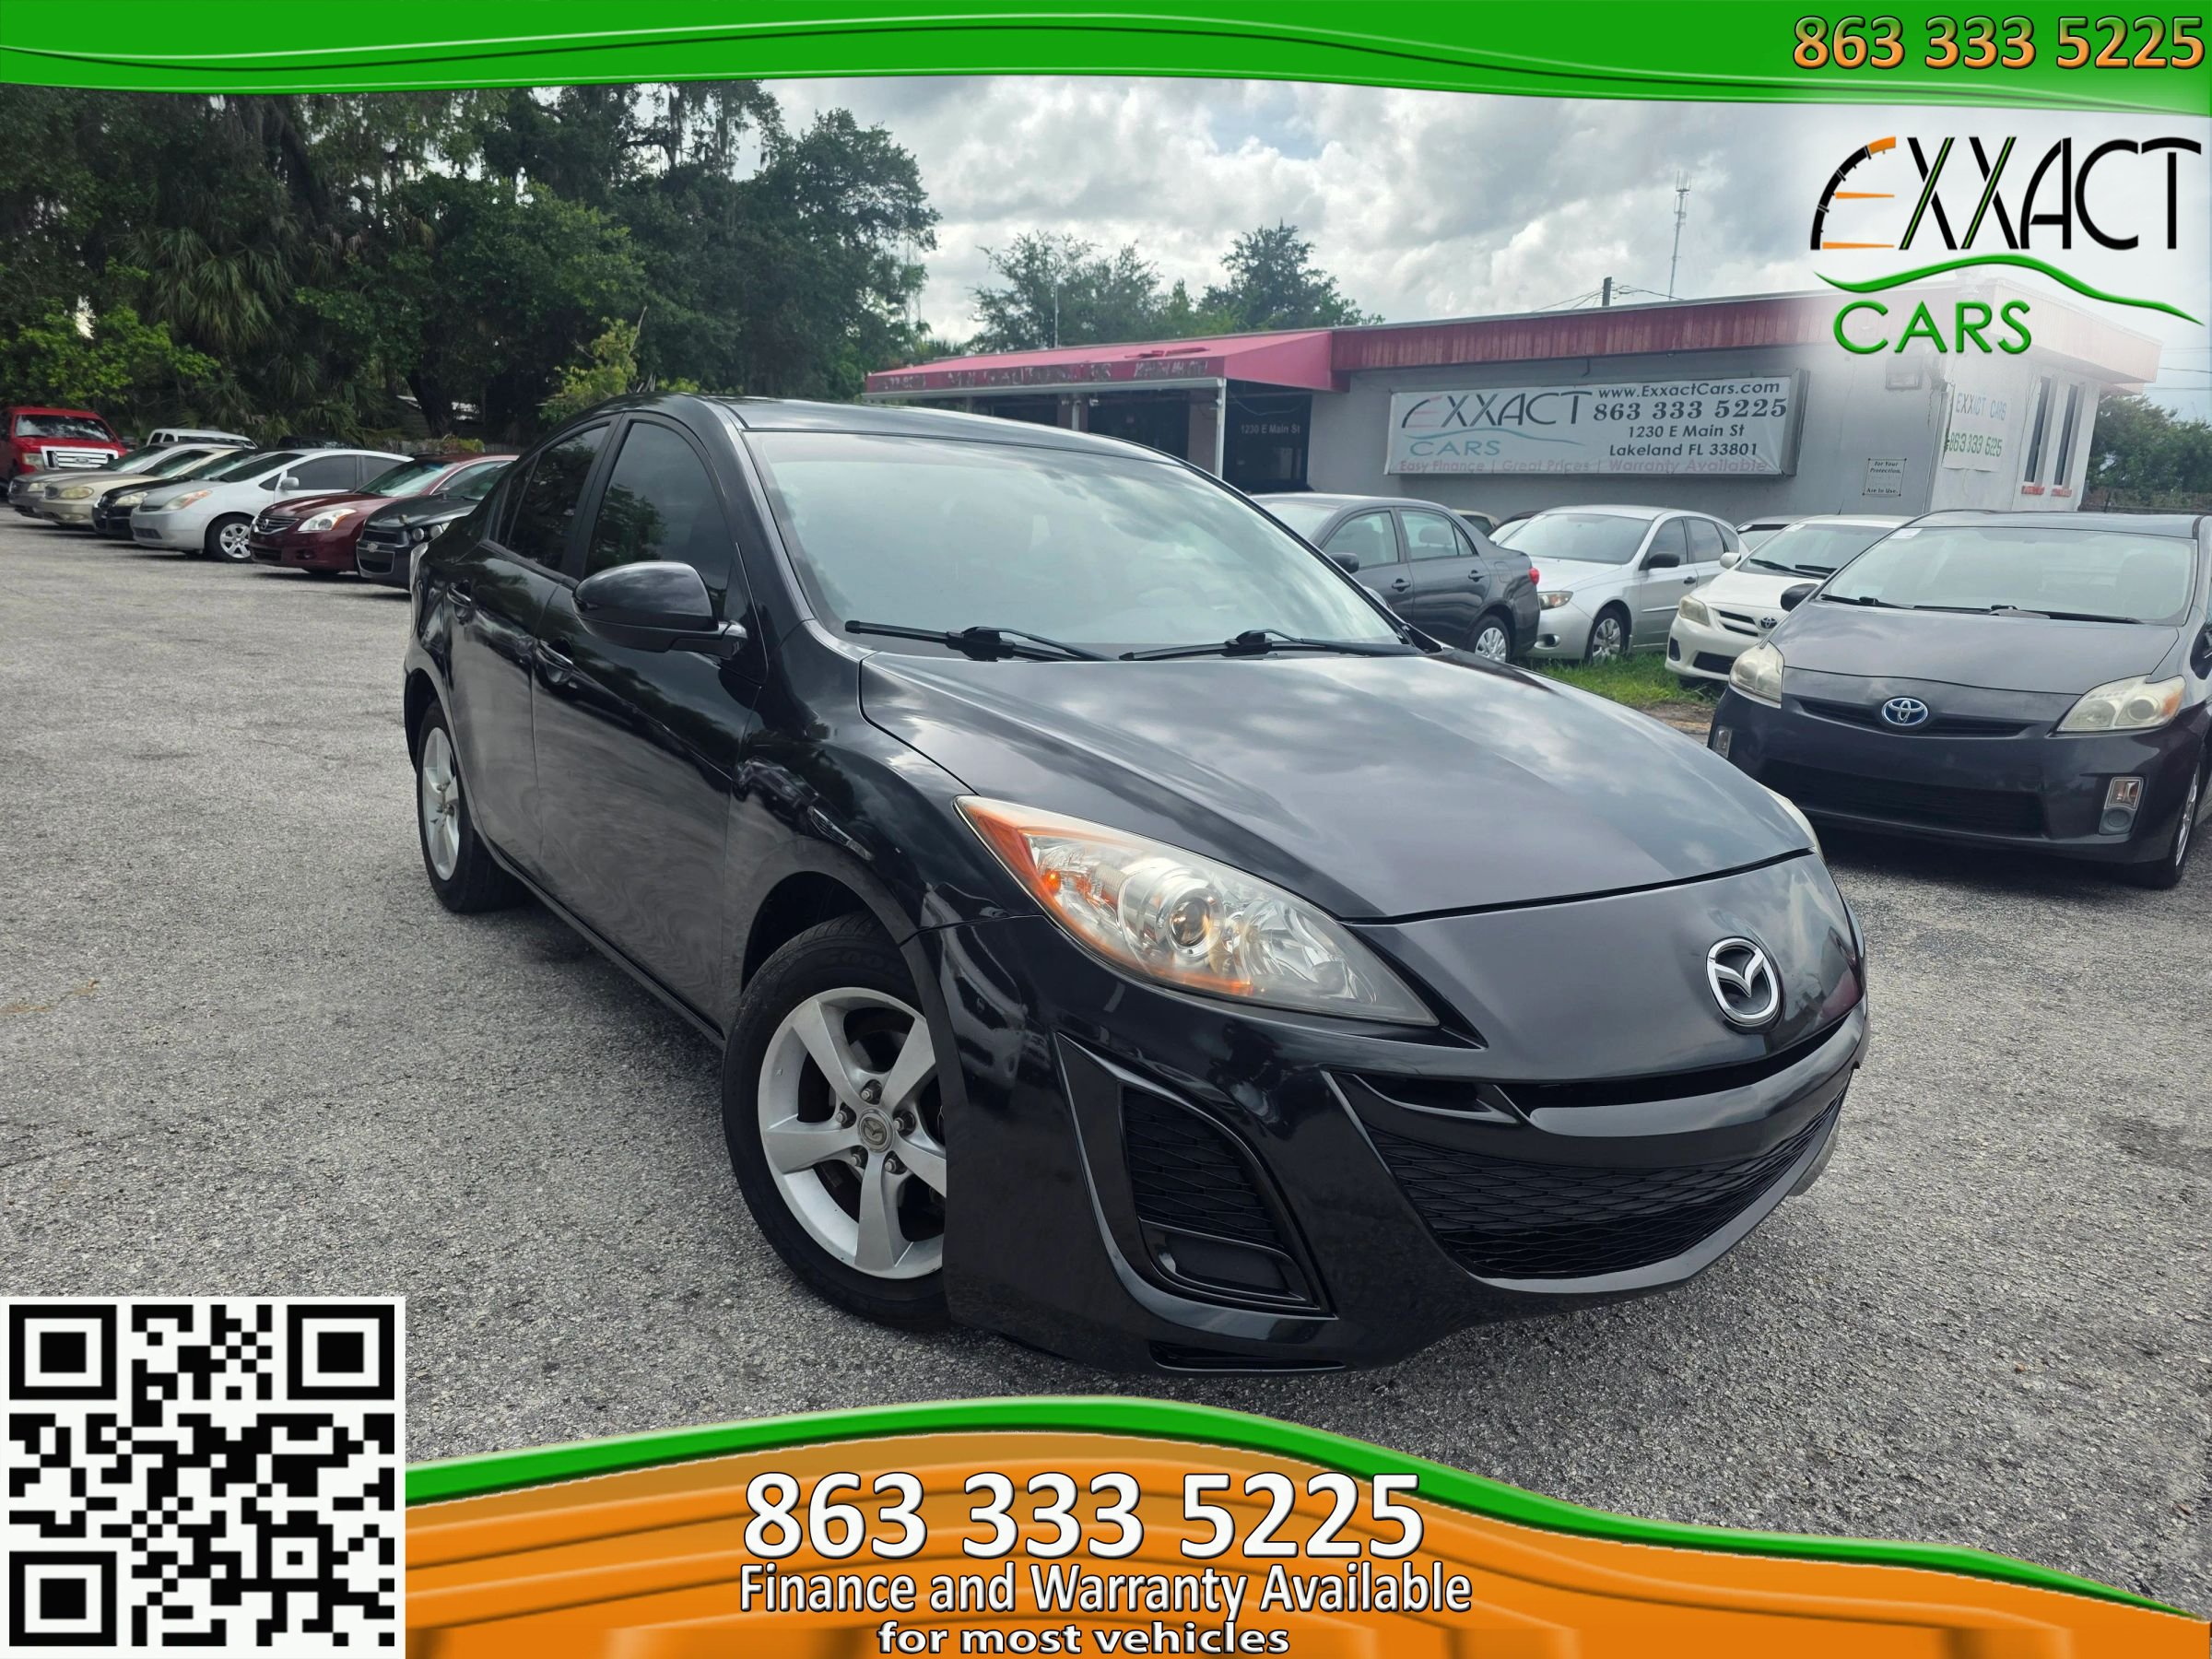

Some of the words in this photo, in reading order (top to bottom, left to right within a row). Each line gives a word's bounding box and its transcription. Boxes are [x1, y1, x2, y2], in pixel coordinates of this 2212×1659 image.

[1599, 382, 1780, 398] www.ExxactCars.com
[1402, 391, 1593, 428] EXXACT
[1594, 403, 1641, 420] 863
[1653, 401, 1702, 419] 333
[1714, 398, 1787, 418] 5225
[1629, 426, 1664, 438] 1230
[1669, 426, 1677, 437] E
[1682, 424, 1724, 437] Main
[1729, 424, 1745, 437] St
[1410, 441, 1500, 456] CARS
[1610, 443, 1682, 456] Lakeland
[1688, 444, 1704, 455] FL
[1709, 443, 1757, 455] 33801
[1400, 461, 1430, 473] Easy
[1432, 461, 1484, 472] Finance
[1502, 461, 1542, 472] Great
[1547, 461, 1590, 472] Prices
[1608, 460, 1681, 474] Warranty
[1685, 459, 1768, 472] Available
